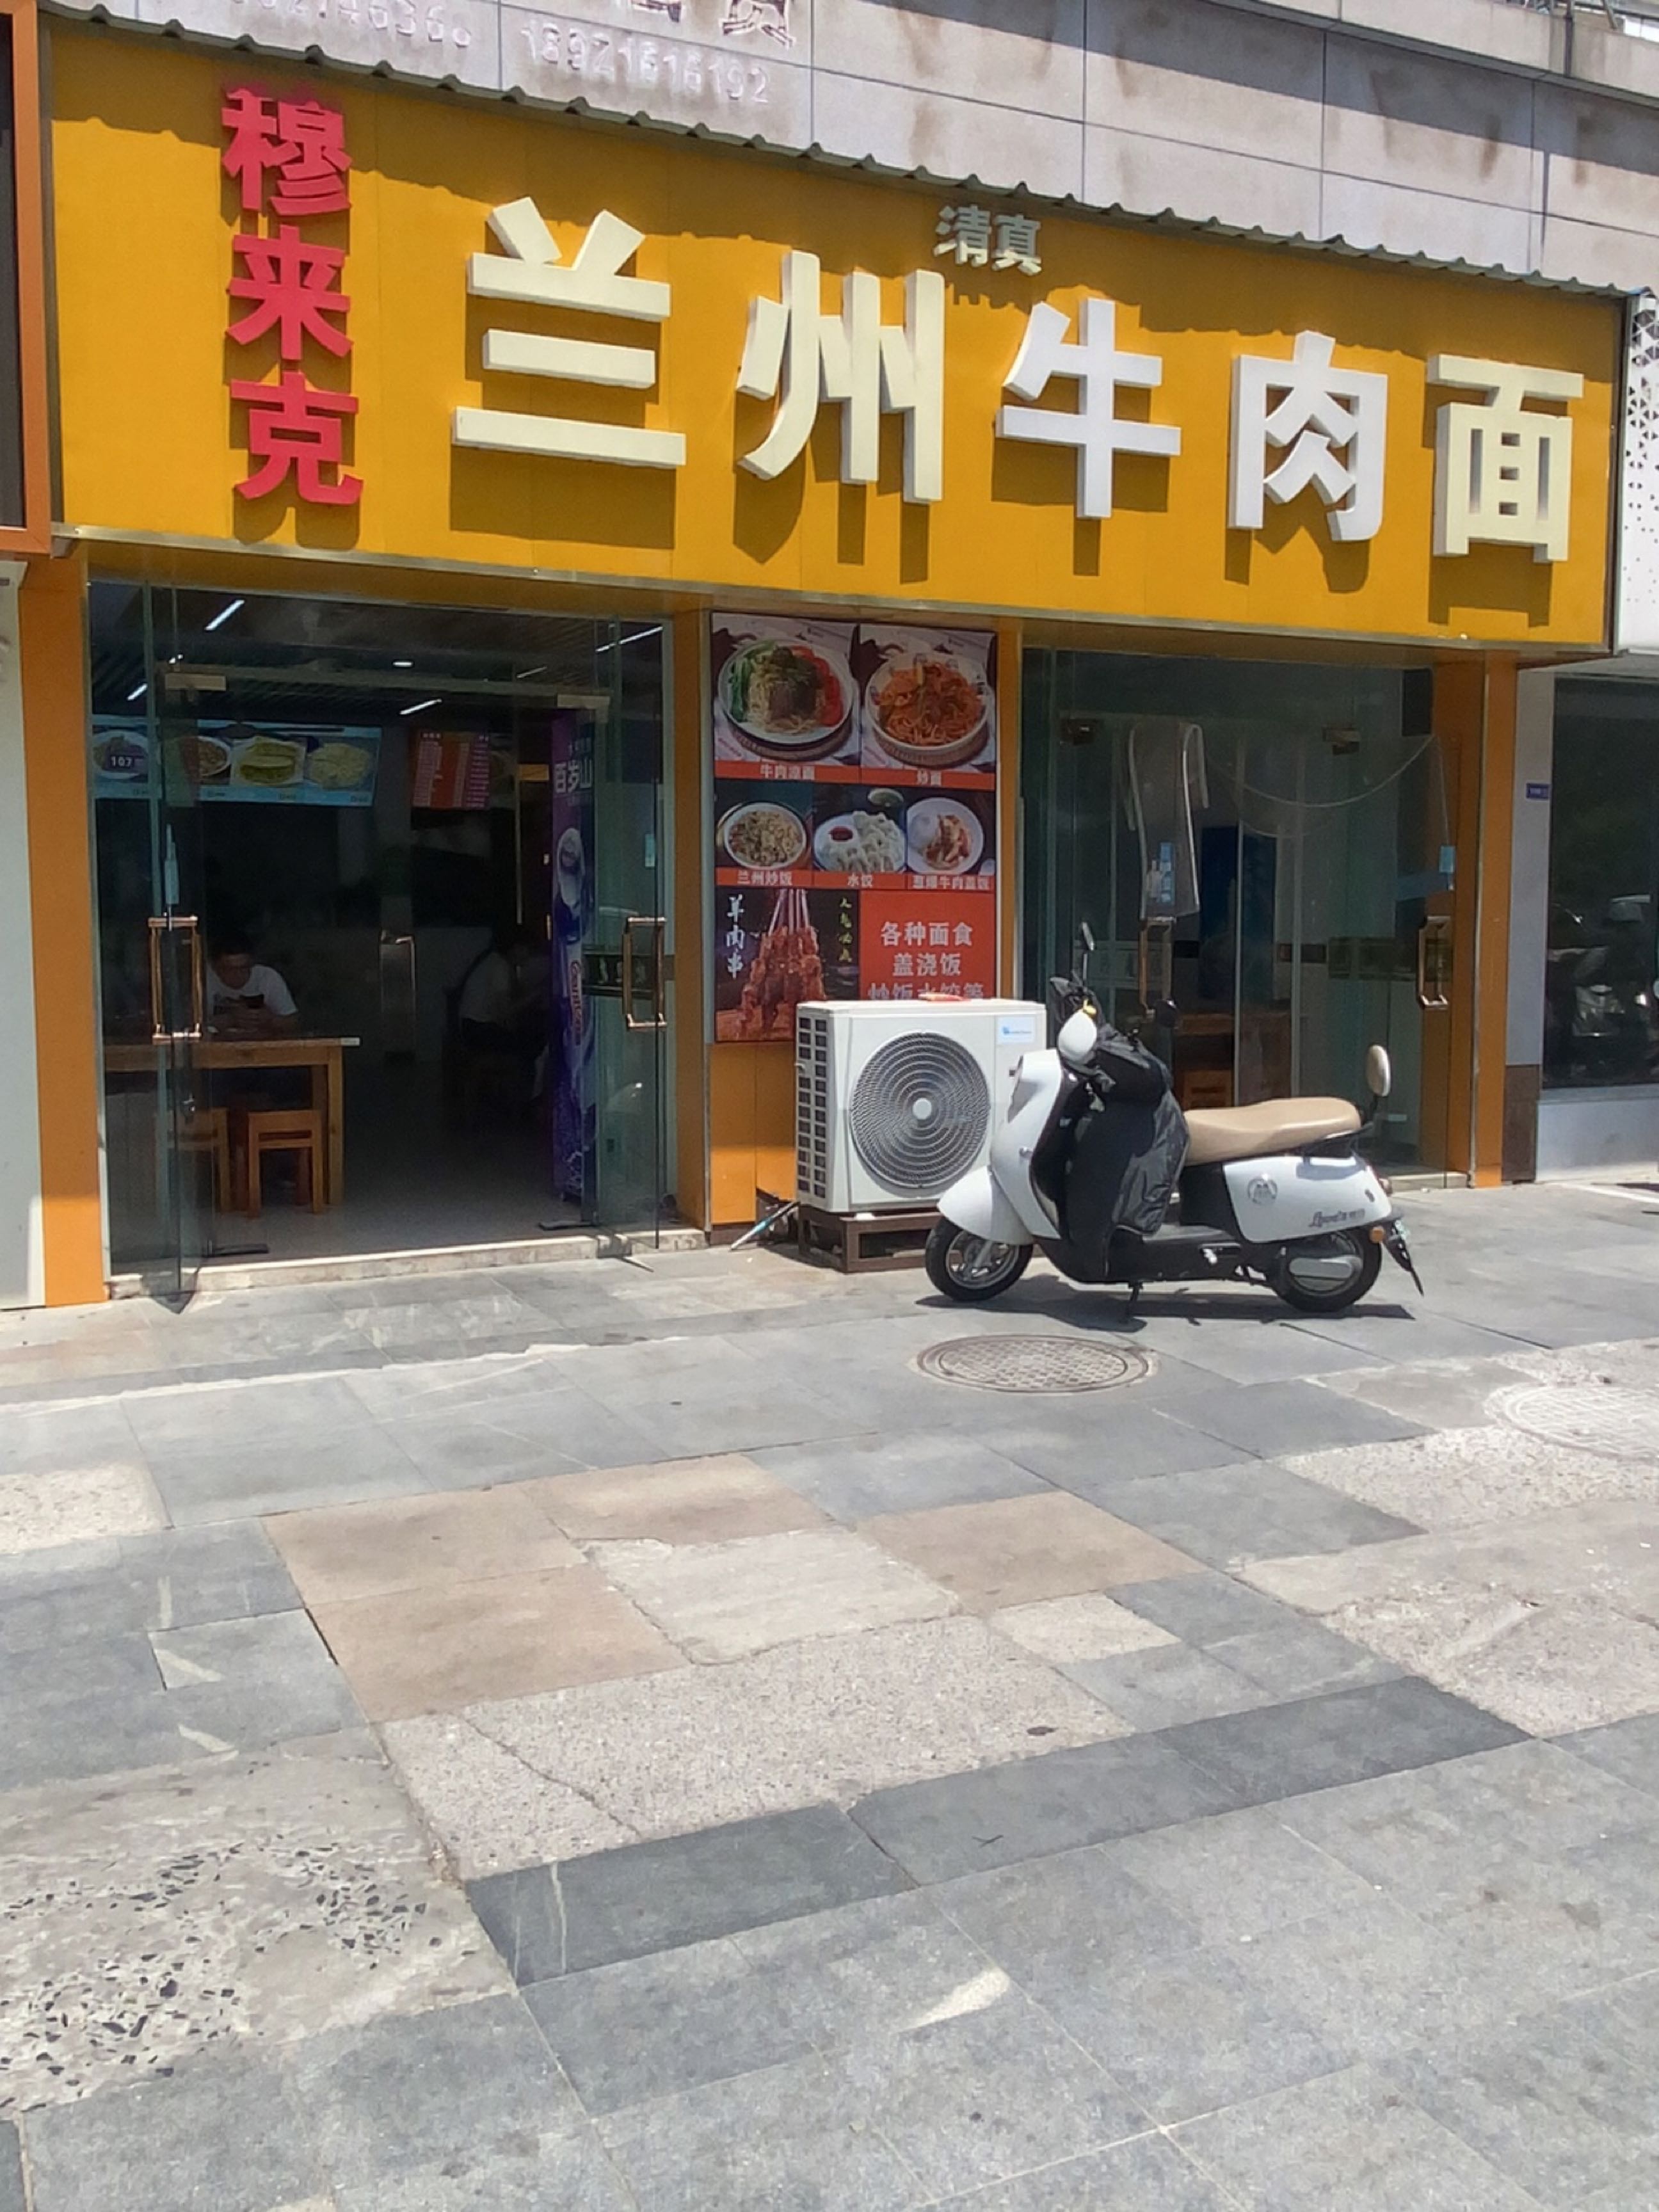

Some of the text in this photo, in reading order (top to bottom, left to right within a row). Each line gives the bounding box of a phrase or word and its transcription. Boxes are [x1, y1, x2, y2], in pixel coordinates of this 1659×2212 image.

[933, 204, 1042, 276] 清真
[221, 87, 363, 506] 穆来克
[452, 197, 1584, 562] 兰州牛肉面
[111, 756, 132, 767] 107
[726, 894, 746, 979] 羊肉串
[881, 921, 973, 947] 各种面食
[892, 952, 962, 976] 盖浇饭
